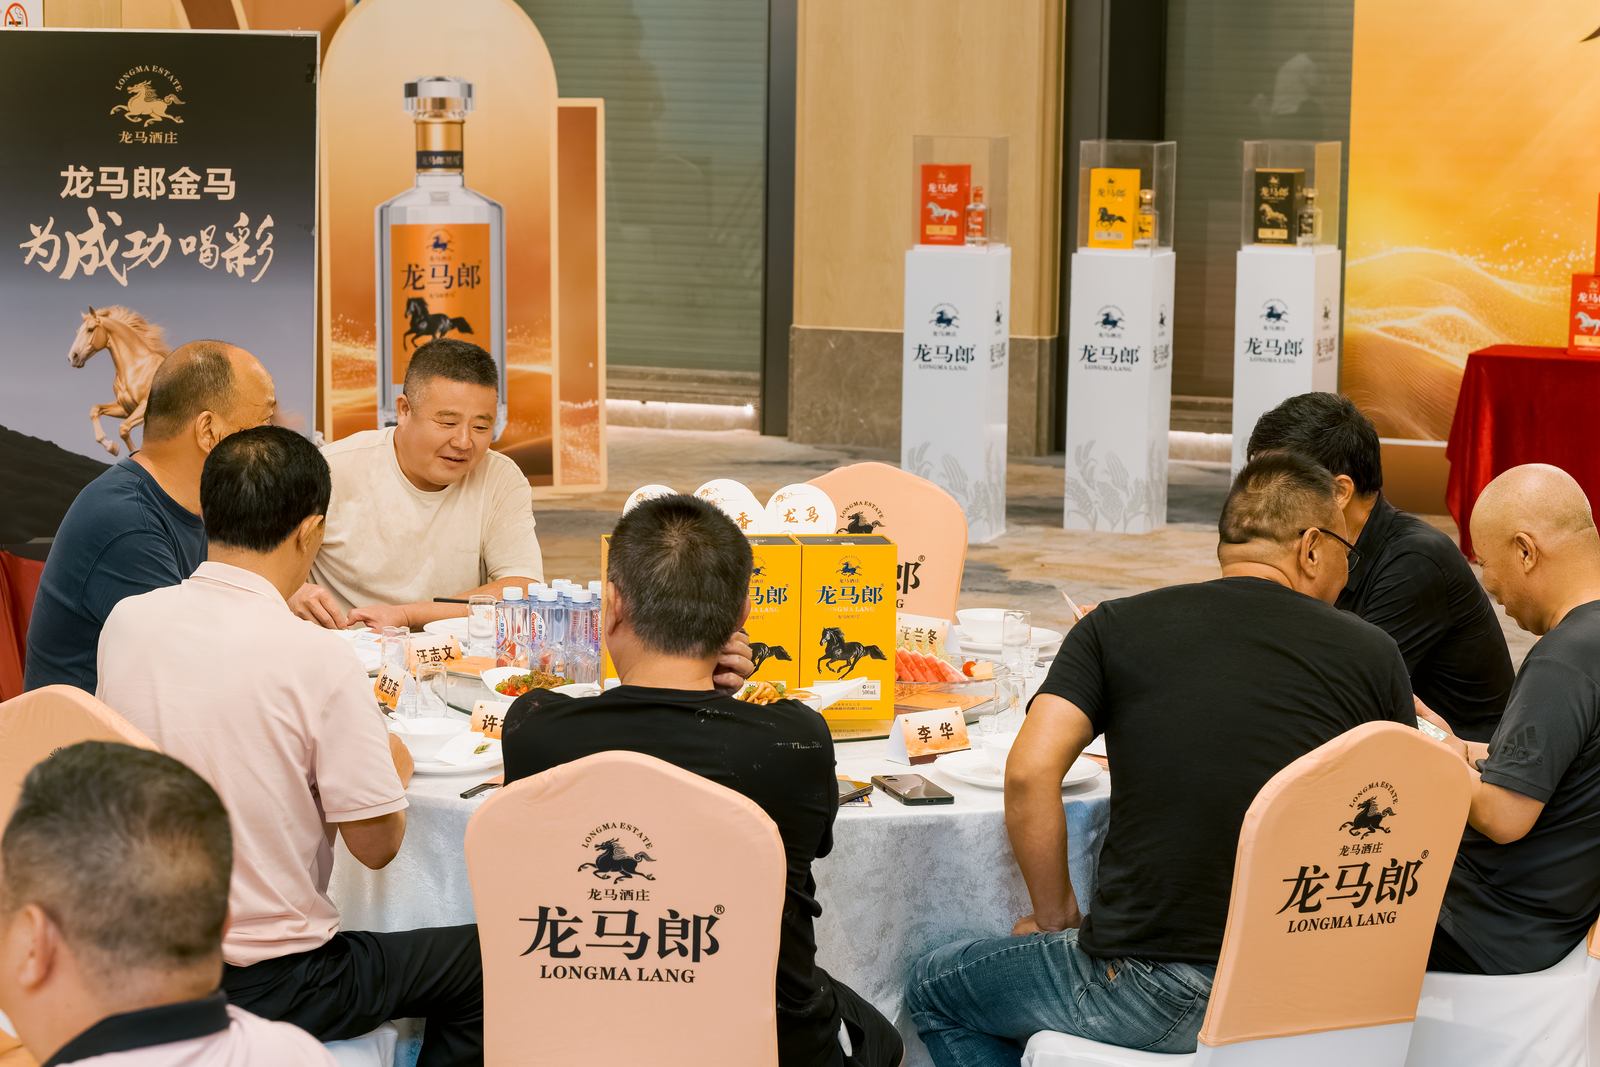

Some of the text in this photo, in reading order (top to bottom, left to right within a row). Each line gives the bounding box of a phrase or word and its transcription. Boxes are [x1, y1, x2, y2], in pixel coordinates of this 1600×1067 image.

[115, 65, 184, 93] LONGMA ESTATE
[118, 131, 179, 145] 龙马酒庄
[59, 165, 236, 201] 龙马郎金马
[19, 206, 275, 287] 为成功喝彩
[401, 263, 481, 290] 龙马郎
[912, 344, 975, 363] 龙马郎
[1078, 345, 1139, 364] 龙马郎
[1244, 337, 1303, 357] 龙马郎
[839, 500, 884, 519] LONGMA ESTATE
[748, 586, 788, 605] 马郎
[816, 585, 883, 604] 龙马郎
[416, 644, 455, 665] 汪志文
[917, 721, 954, 743] 李华
[1349, 780, 1399, 808] LONGMA ESTATE
[581, 821, 653, 850] LONGMA ESTATE
[1338, 841, 1384, 857] 龙马酒庄
[587, 888, 650, 902] 龙马酒庄
[1275, 858, 1424, 916] 龙马郎
[1287, 911, 1397, 934] LONGMA LANG
[519, 905, 721, 963] 龙马郎
[540, 965, 696, 983] LONGMA LANG
